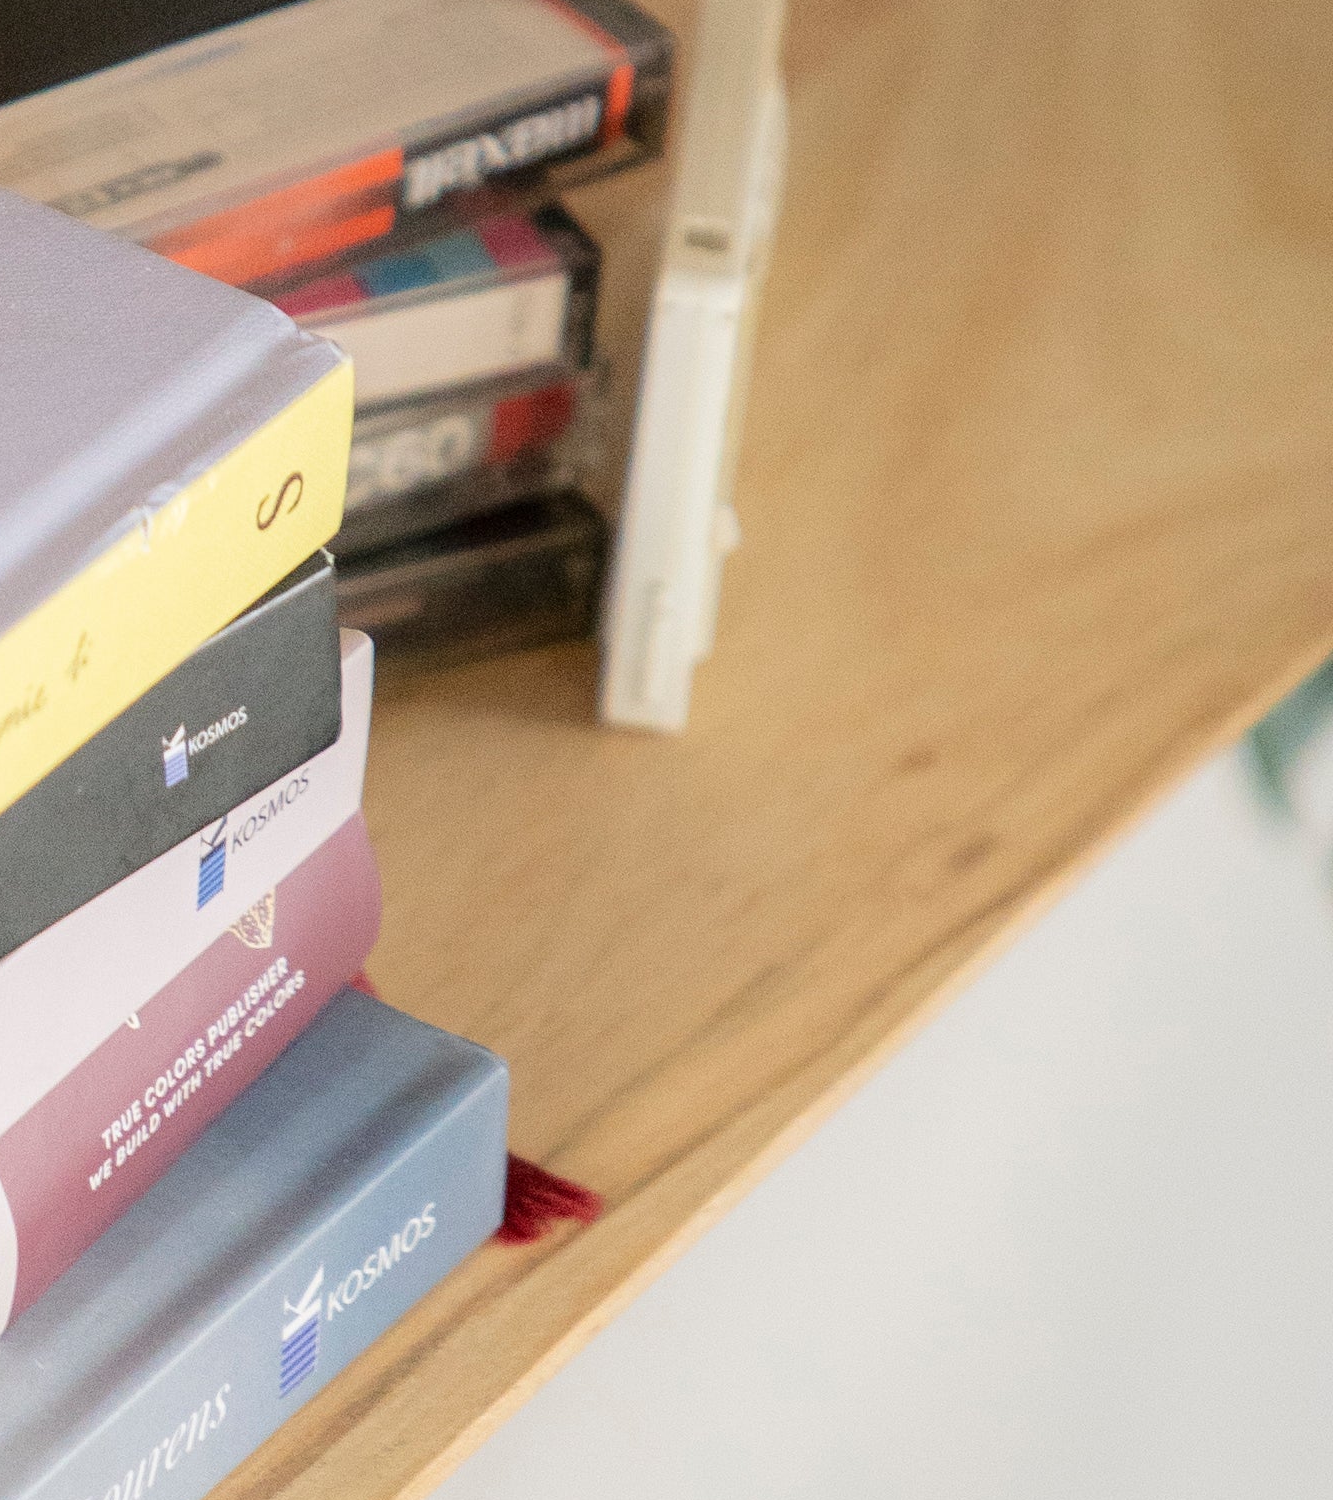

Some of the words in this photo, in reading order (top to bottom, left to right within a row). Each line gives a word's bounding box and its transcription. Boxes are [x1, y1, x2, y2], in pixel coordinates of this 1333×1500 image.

[188, 705, 248, 757] KOSMOS
[231, 768, 310, 854] KOSMOS
[88, 1158, 114, 1192] WE
[115, 1111, 162, 1168] BUILD
[162, 1070, 203, 1119] WITH
[203, 1030, 243, 1078] TRUE
[244, 968, 306, 1039] COLORS
[100, 1099, 143, 1151] TRUE
[144, 1038, 207, 1109] COLORS
[206, 955, 289, 1048] PUBLISHER
[325, 1201, 437, 1322] KOSMOS
